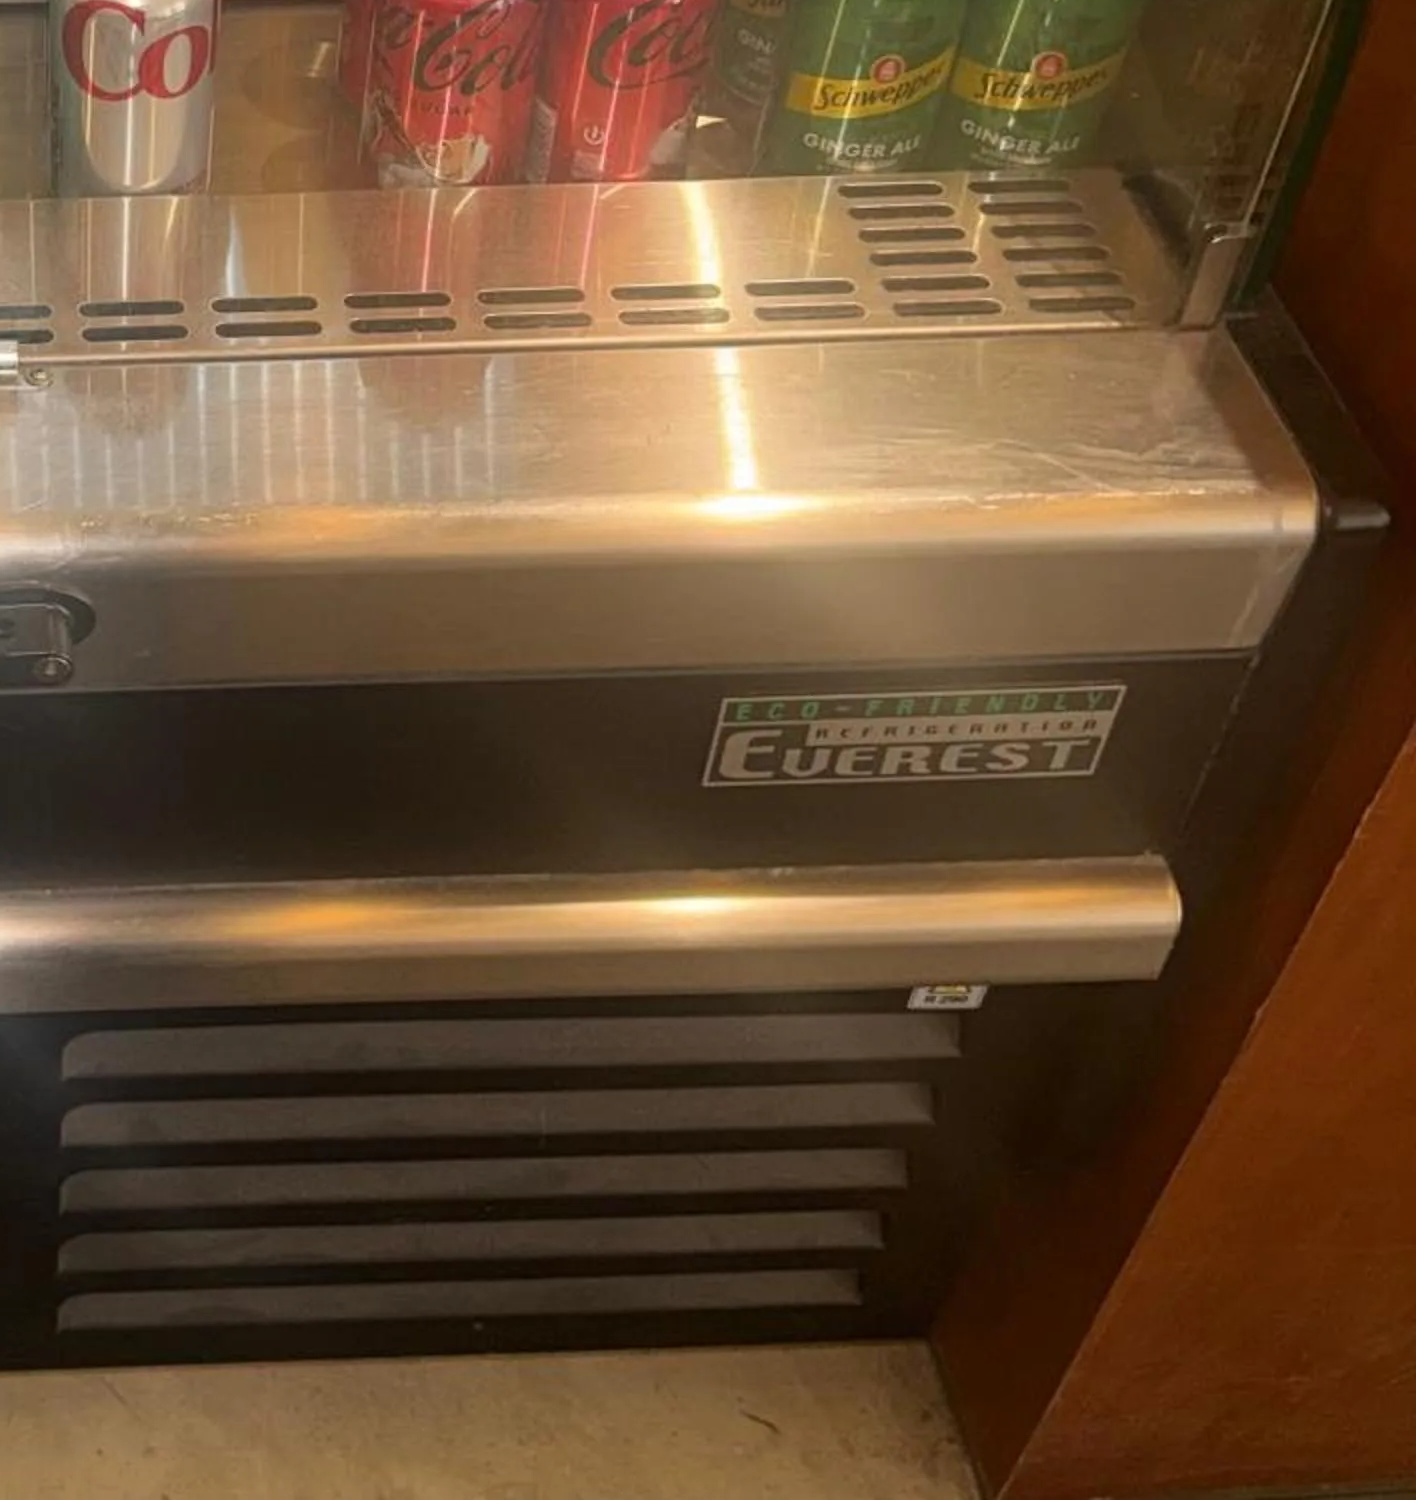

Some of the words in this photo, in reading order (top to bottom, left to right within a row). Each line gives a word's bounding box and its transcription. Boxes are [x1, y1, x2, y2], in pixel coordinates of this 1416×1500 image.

[803, 132, 886, 158] GINGER
[960, 118, 1042, 153] GINGER
[735, 691, 1107, 722] ECO-FRIENDLY
[815, 718, 1099, 741] REFRIGERATION
